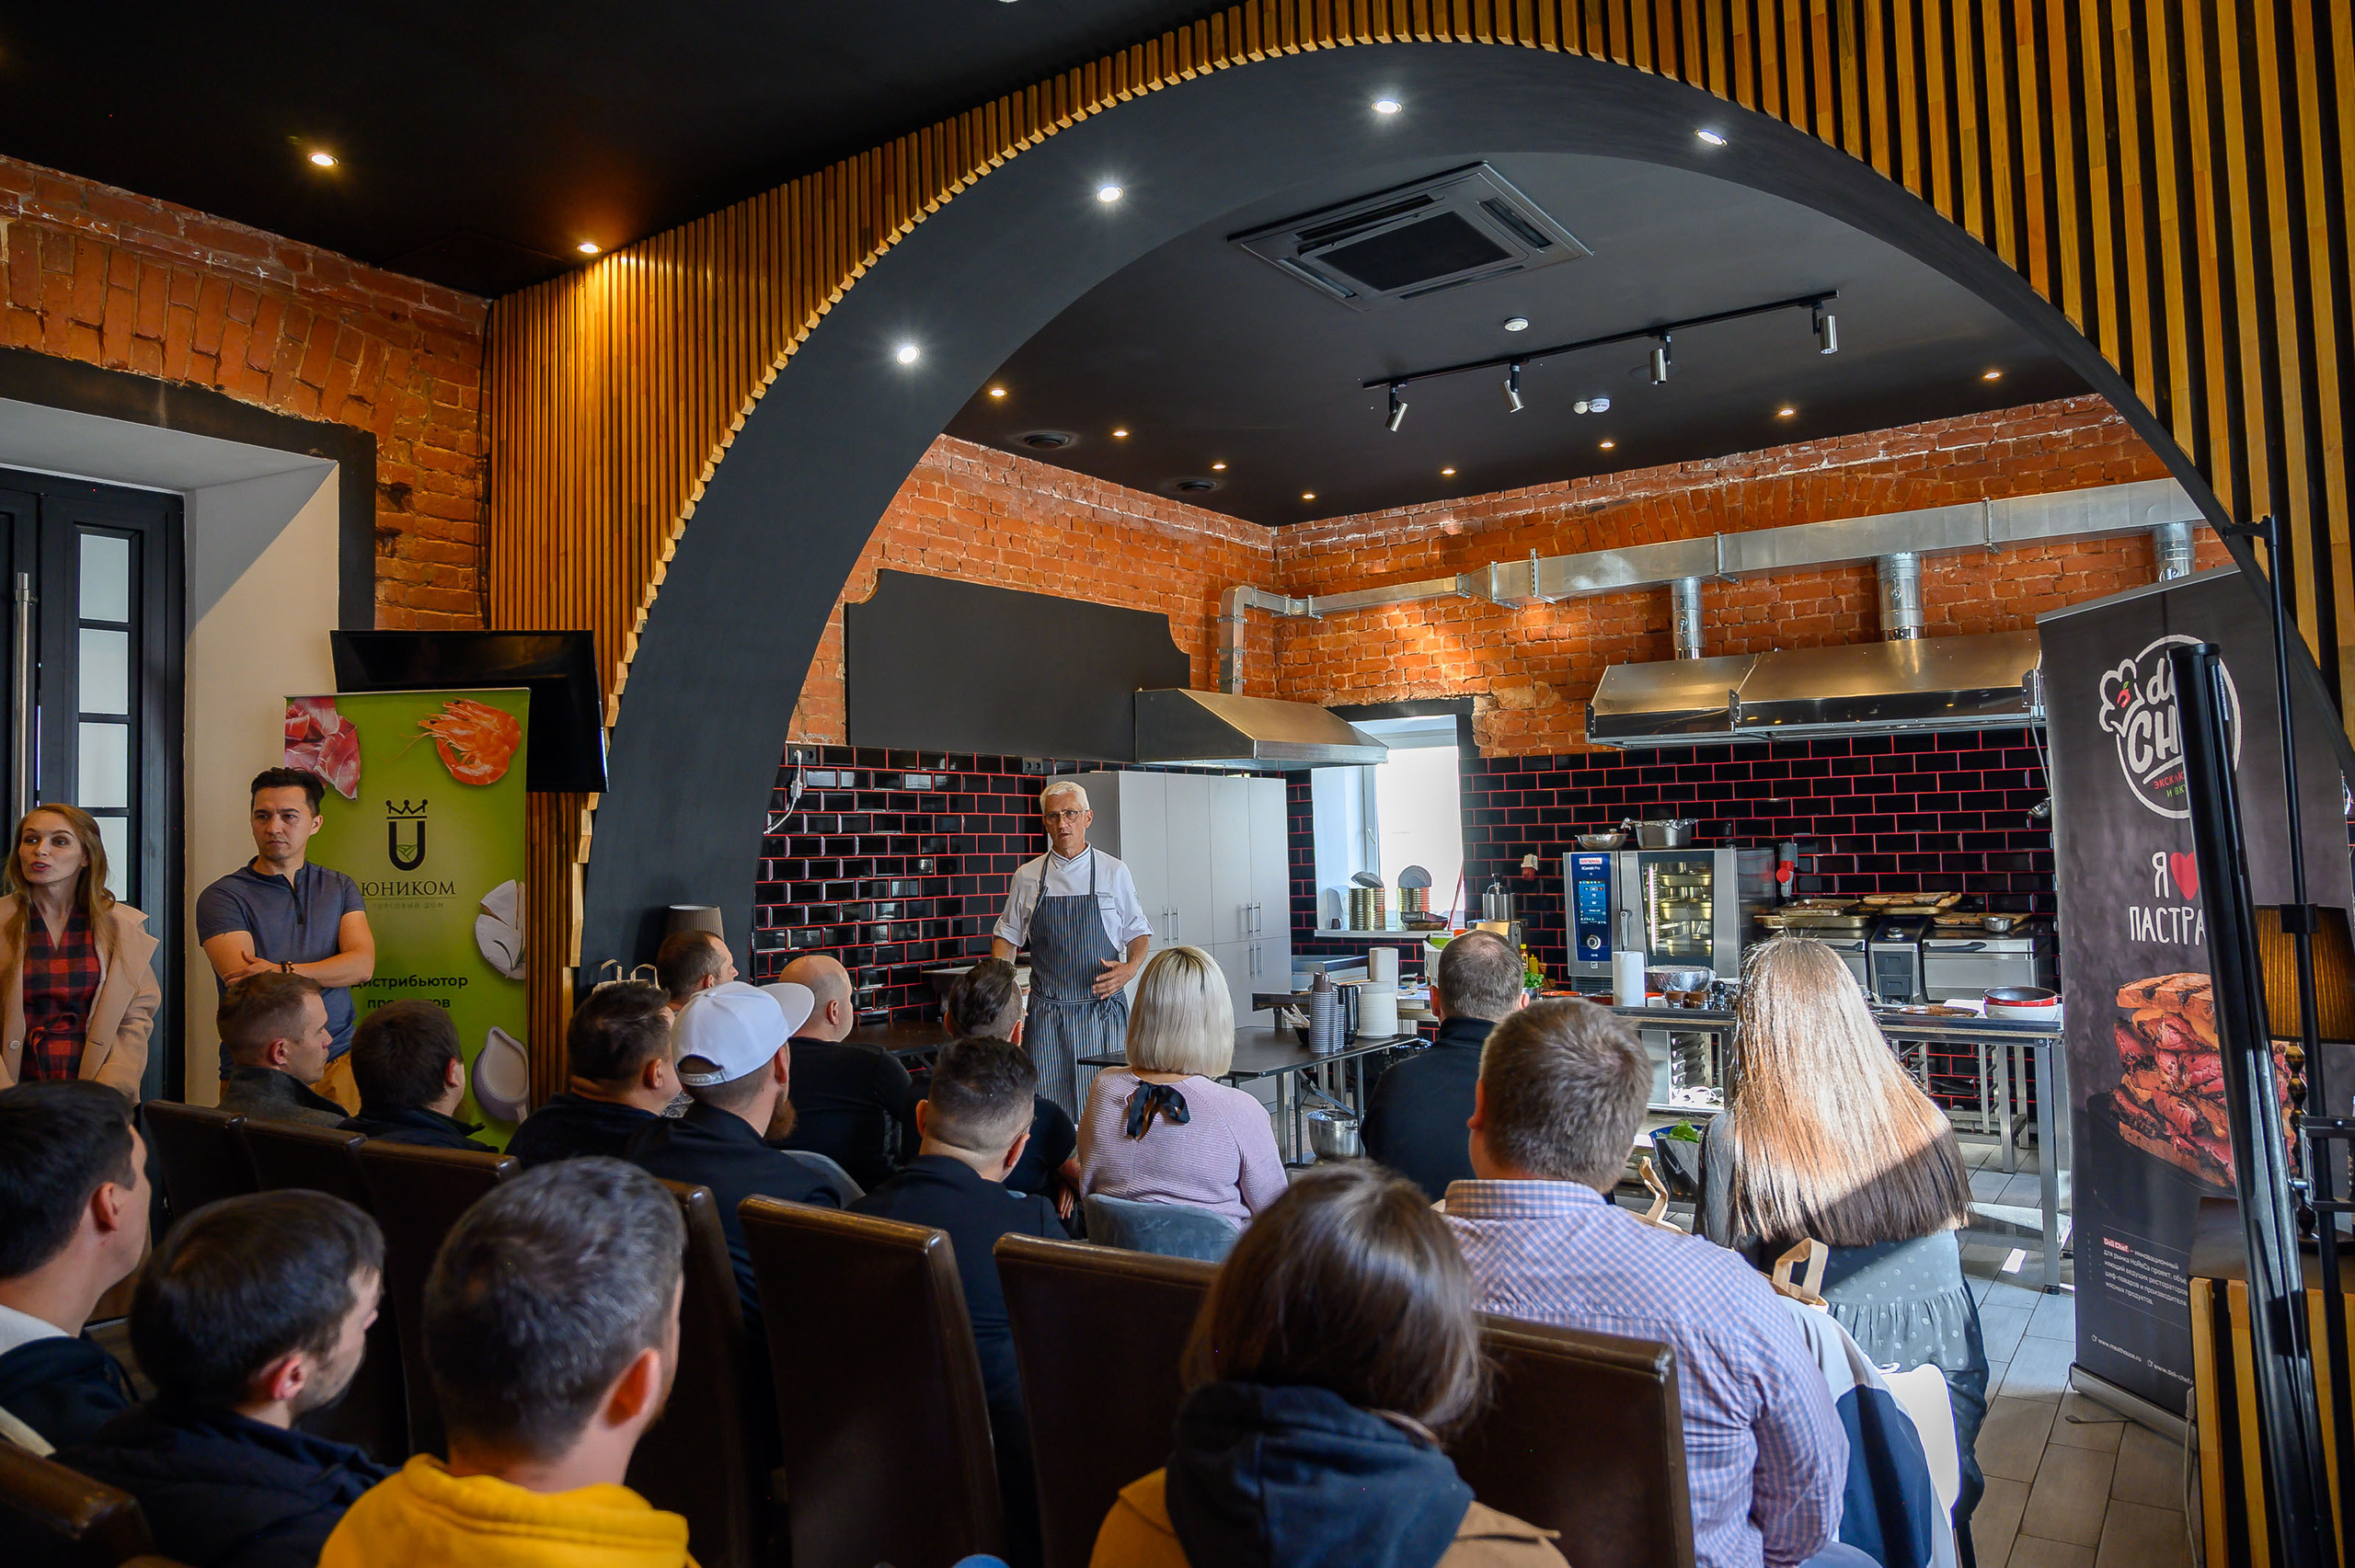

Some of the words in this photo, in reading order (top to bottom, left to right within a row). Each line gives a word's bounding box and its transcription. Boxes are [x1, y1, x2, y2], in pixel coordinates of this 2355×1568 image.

[2128, 705, 2178, 773] CH
[361, 880, 456, 897] ЮНИКОМ
[2152, 851, 2170, 898] Я
[2129, 906, 2207, 946] ПАСТРА
